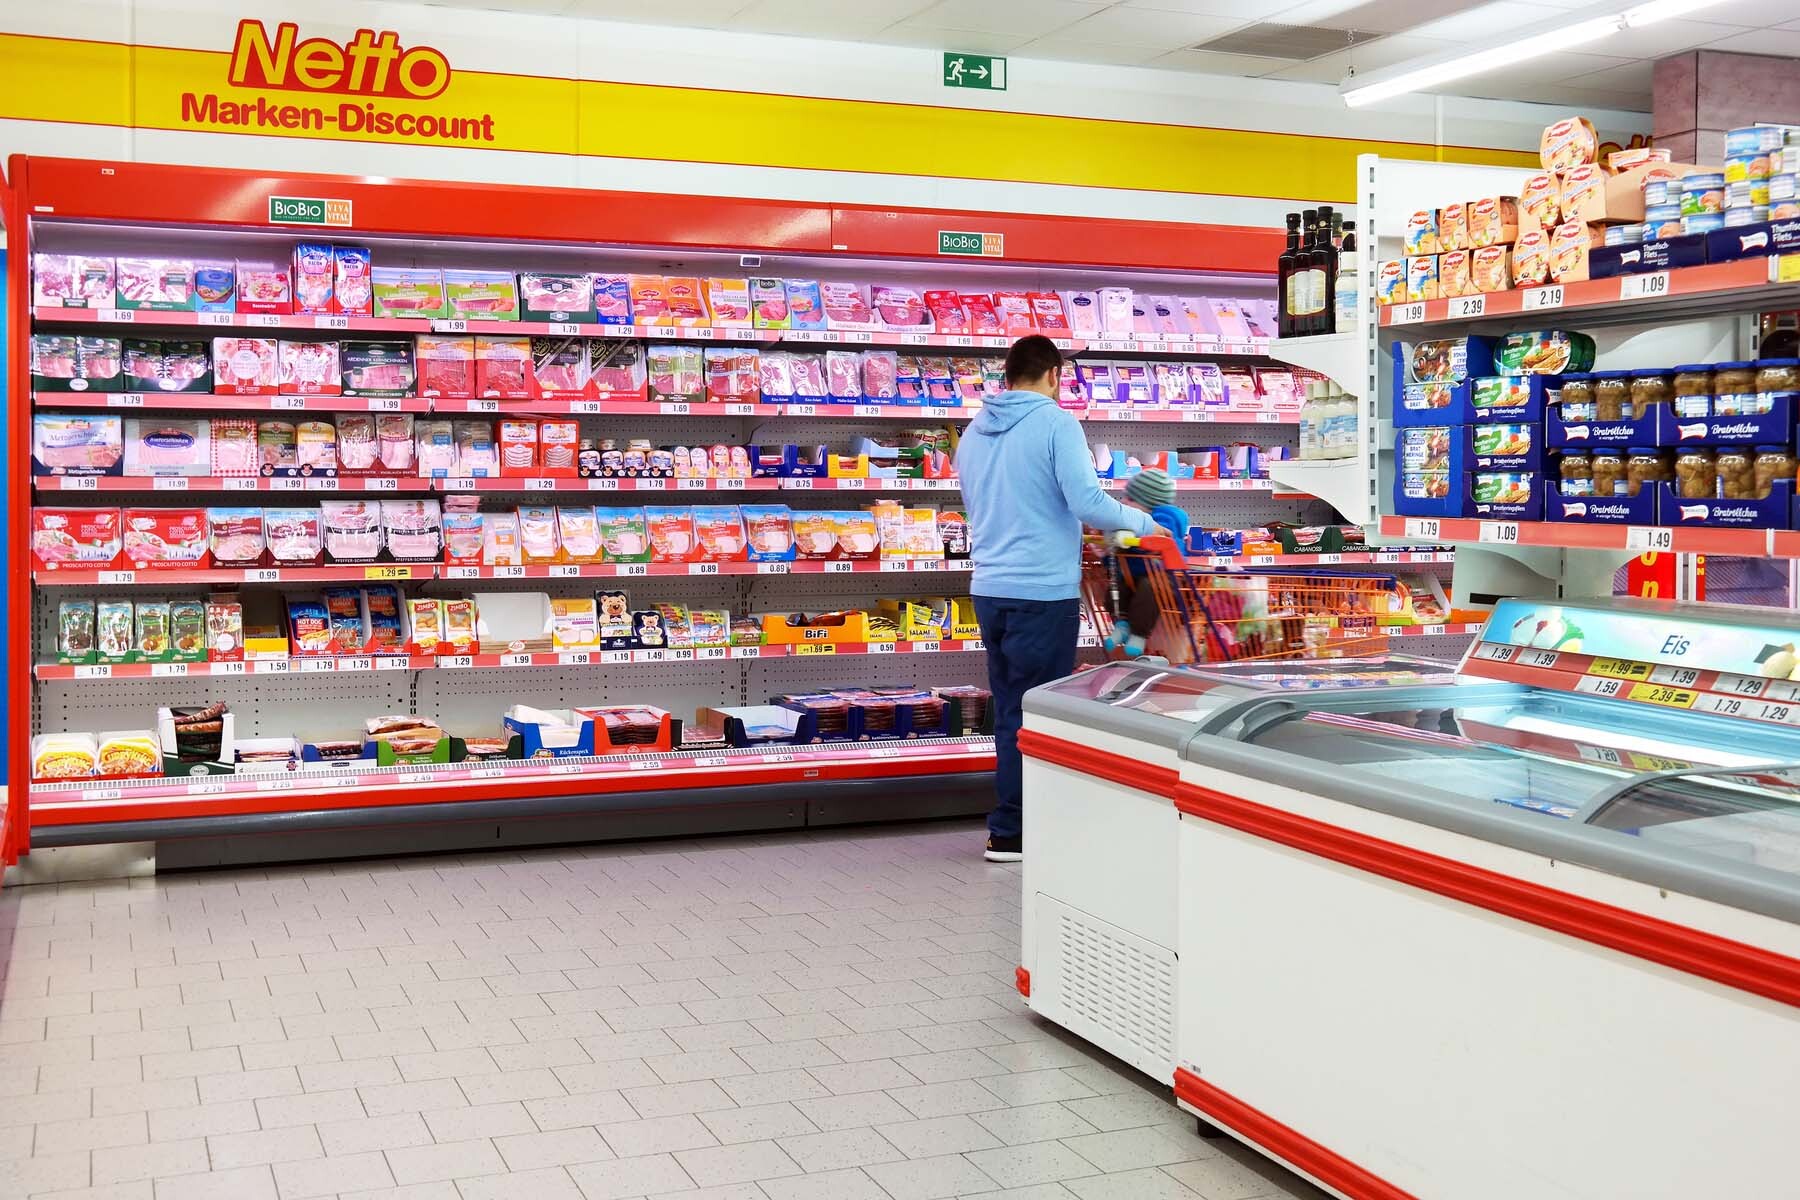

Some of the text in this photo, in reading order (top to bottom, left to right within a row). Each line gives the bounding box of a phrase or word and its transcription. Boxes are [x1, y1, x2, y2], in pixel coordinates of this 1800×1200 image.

[228, 19, 451, 100] Netto
[181, 93, 495, 141] Marken-Discount
[327, 202, 349, 212] VIVA
[327, 212, 348, 221] VITAL
[1642, 275, 1664, 292] 1.09
[1540, 289, 1561, 305] 2.19
[1463, 300, 1482, 315] 2.39
[115, 312, 132, 320] 1.69
[1405, 305, 1422, 320] 1.99
[214, 315, 230, 323] 1.69
[262, 317, 279, 325] 1.55
[330, 319, 347, 327] 0.89
[450, 322, 464, 330] 1.99
[697, 329, 711, 337] 1.49
[738, 331, 753, 339] 0.99
[796, 332, 810, 340] 1.49
[823, 333, 838, 341] 0.99
[958, 337, 971, 345] 1.69
[123, 396, 141, 404] 1.79
[287, 399, 304, 407] 1.29
[383, 401, 398, 409] 1.99
[481, 402, 496, 410] 1.99
[865, 407, 879, 415] 1.29
[933, 408, 946, 416] 1.29
[77, 479, 95, 487] 1.99
[168, 480, 186, 488] 11.99
[238, 480, 255, 489] 1.49
[285, 480, 301, 488] 1.99
[320, 480, 336, 488] 1.99
[379, 480, 396, 488] 1.29
[458, 480, 474, 488] 1.19
[538, 480, 553, 488] 1.29
[601, 480, 616, 488] 1.79
[649, 480, 663, 488] 1.79
[689, 480, 704, 488] 0.99
[728, 480, 743, 488] 0.99
[796, 480, 810, 488] 0.75
[849, 479, 862, 487] 1.39
[894, 480, 907, 488] 1.39
[923, 480, 936, 488] 1.09
[1420, 521, 1437, 536] 1.79
[1497, 525, 1516, 541] 1.09
[1647, 531, 1670, 548] 1.49
[1261, 556, 1272, 564] 1.99
[507, 567, 522, 575] 1.59
[562, 567, 577, 575] 1.49
[629, 566, 644, 574] 0.89
[701, 565, 716, 573] 0.89
[835, 563, 850, 572] 0.89
[259, 571, 277, 579] 0.99
[381, 569, 396, 577] 1.29
[462, 568, 477, 577] 1.59
[115, 573, 132, 582] 1.79
[417, 603, 436, 611] ZIMBO
[449, 603, 468, 611] ZIMBO
[805, 629, 829, 639] BiFi
[954, 626, 977, 634] SALAMI
[880, 644, 894, 652] 0.59
[1660, 634, 1690, 656] Eis
[614, 653, 628, 661] 1.19
[647, 652, 662, 660] 1.49
[676, 650, 691, 659] 0.99
[708, 649, 723, 657] 0.99
[743, 649, 757, 657] 0.99
[1491, 646, 1512, 661] 1.39
[391, 659, 407, 667] 1.79
[455, 657, 470, 666] 1.29
[514, 656, 529, 664] 1.99
[572, 655, 587, 663] 1.99
[1534, 652, 1556, 667] 1.39
[226, 663, 242, 671] 1.19
[270, 662, 287, 671] 1.59
[316, 661, 333, 669] 1.79
[353, 660, 369, 668] 1.79
[1609, 661, 1631, 675] 1.99
[90, 667, 107, 675] 1.79
[169, 665, 185, 673] 1.79
[1671, 669, 1697, 684] 1.39
[1595, 680, 1617, 694] 1.59
[1735, 679, 1762, 694] 1.29
[1648, 688, 1673, 703] 2.39
[1714, 698, 1741, 713] 1.79
[1761, 705, 1789, 720] 1.29
